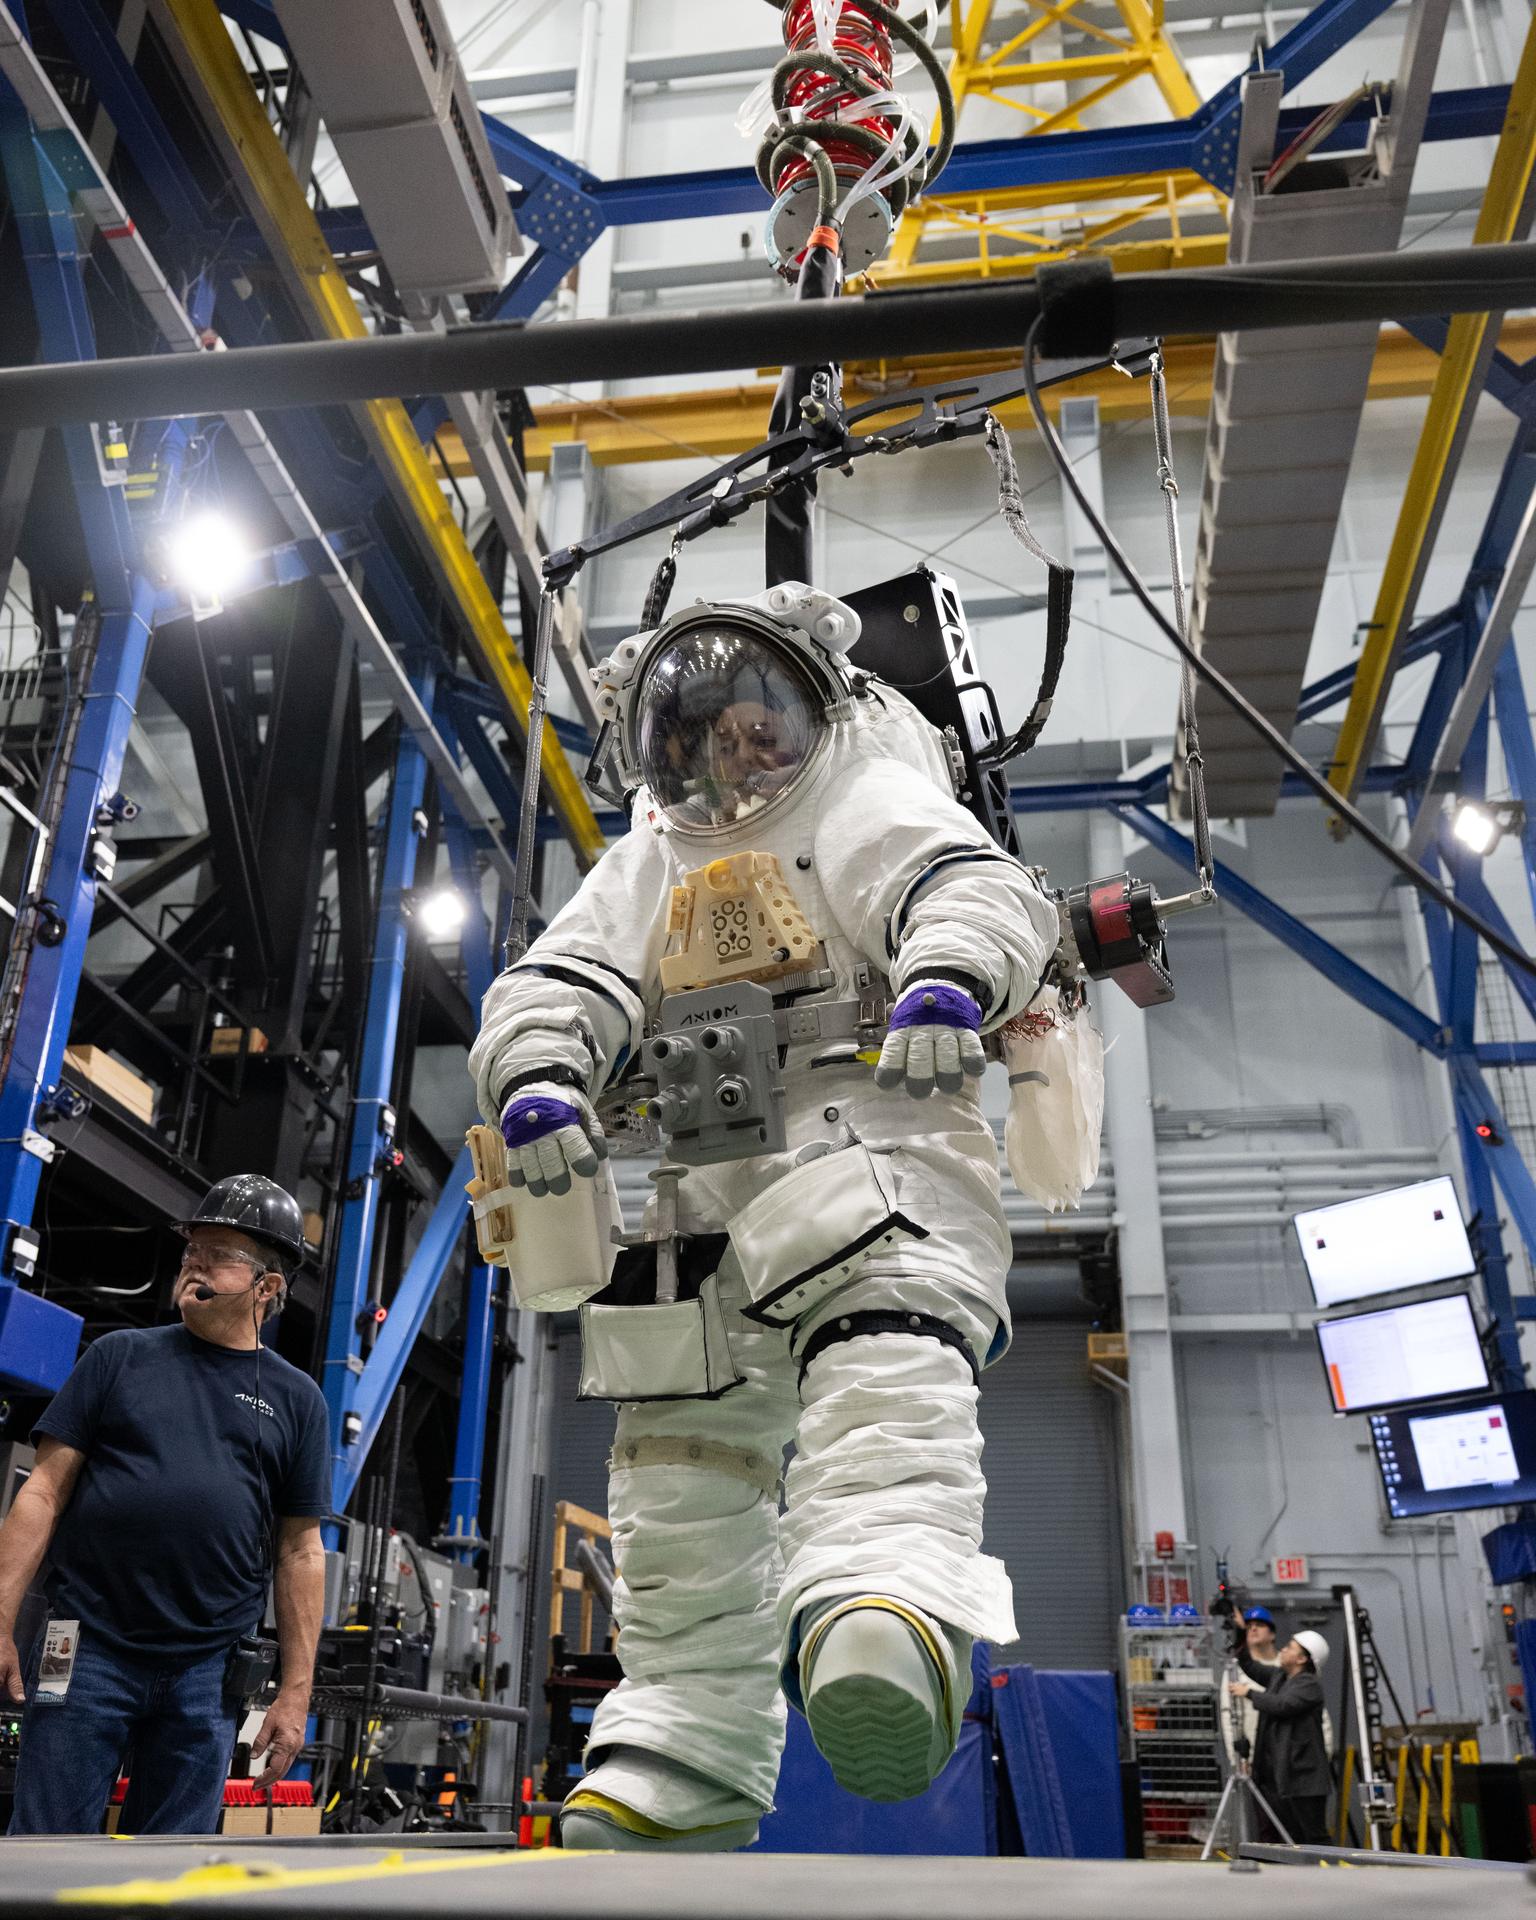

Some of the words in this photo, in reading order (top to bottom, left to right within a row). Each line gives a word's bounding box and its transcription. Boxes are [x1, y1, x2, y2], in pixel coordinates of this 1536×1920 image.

[680, 1004, 739, 1025] AXIOM
[235, 1393, 274, 1413] AXIOM
[251, 1404, 274, 1417] SACE
[1277, 1558, 1304, 1580] EXIT
